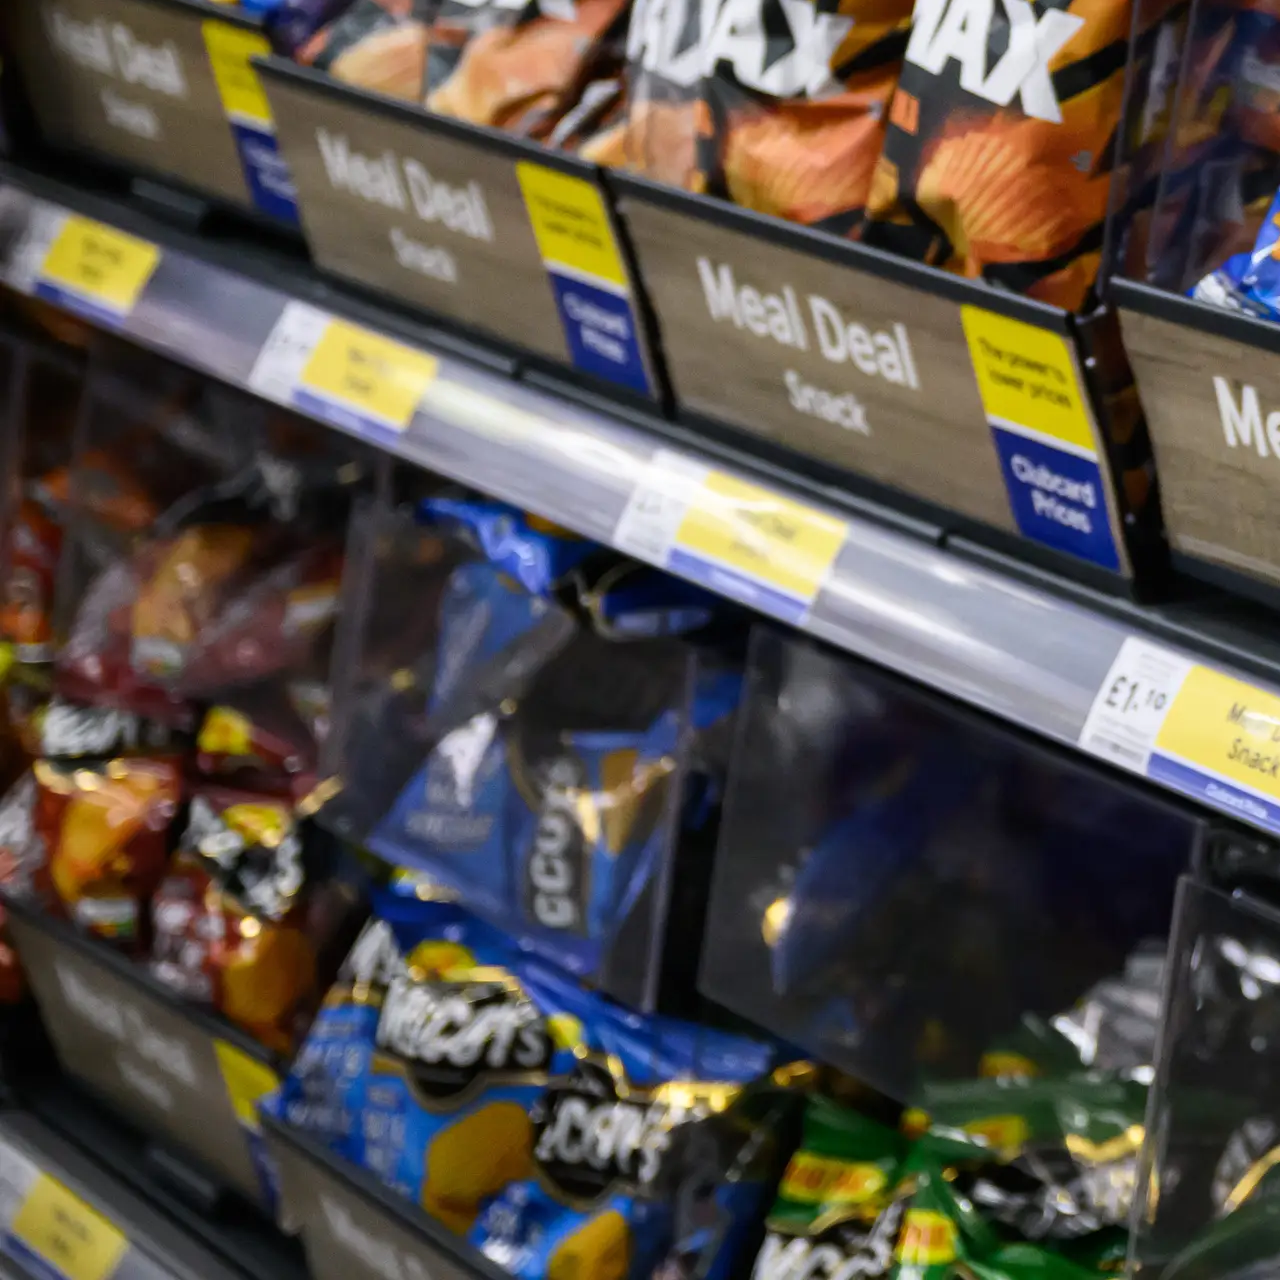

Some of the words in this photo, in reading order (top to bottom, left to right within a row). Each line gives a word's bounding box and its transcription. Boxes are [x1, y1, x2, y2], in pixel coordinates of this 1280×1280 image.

[697, 257, 808, 351] Meal
[807, 293, 922, 390] Deal
[784, 370, 871, 437] Snack
[1010, 452, 1096, 509] Clubcard
[1031, 490, 1093, 535] Prices
[1104, 674, 1168, 714] £1.10
[1227, 738, 1280, 780] Snack
